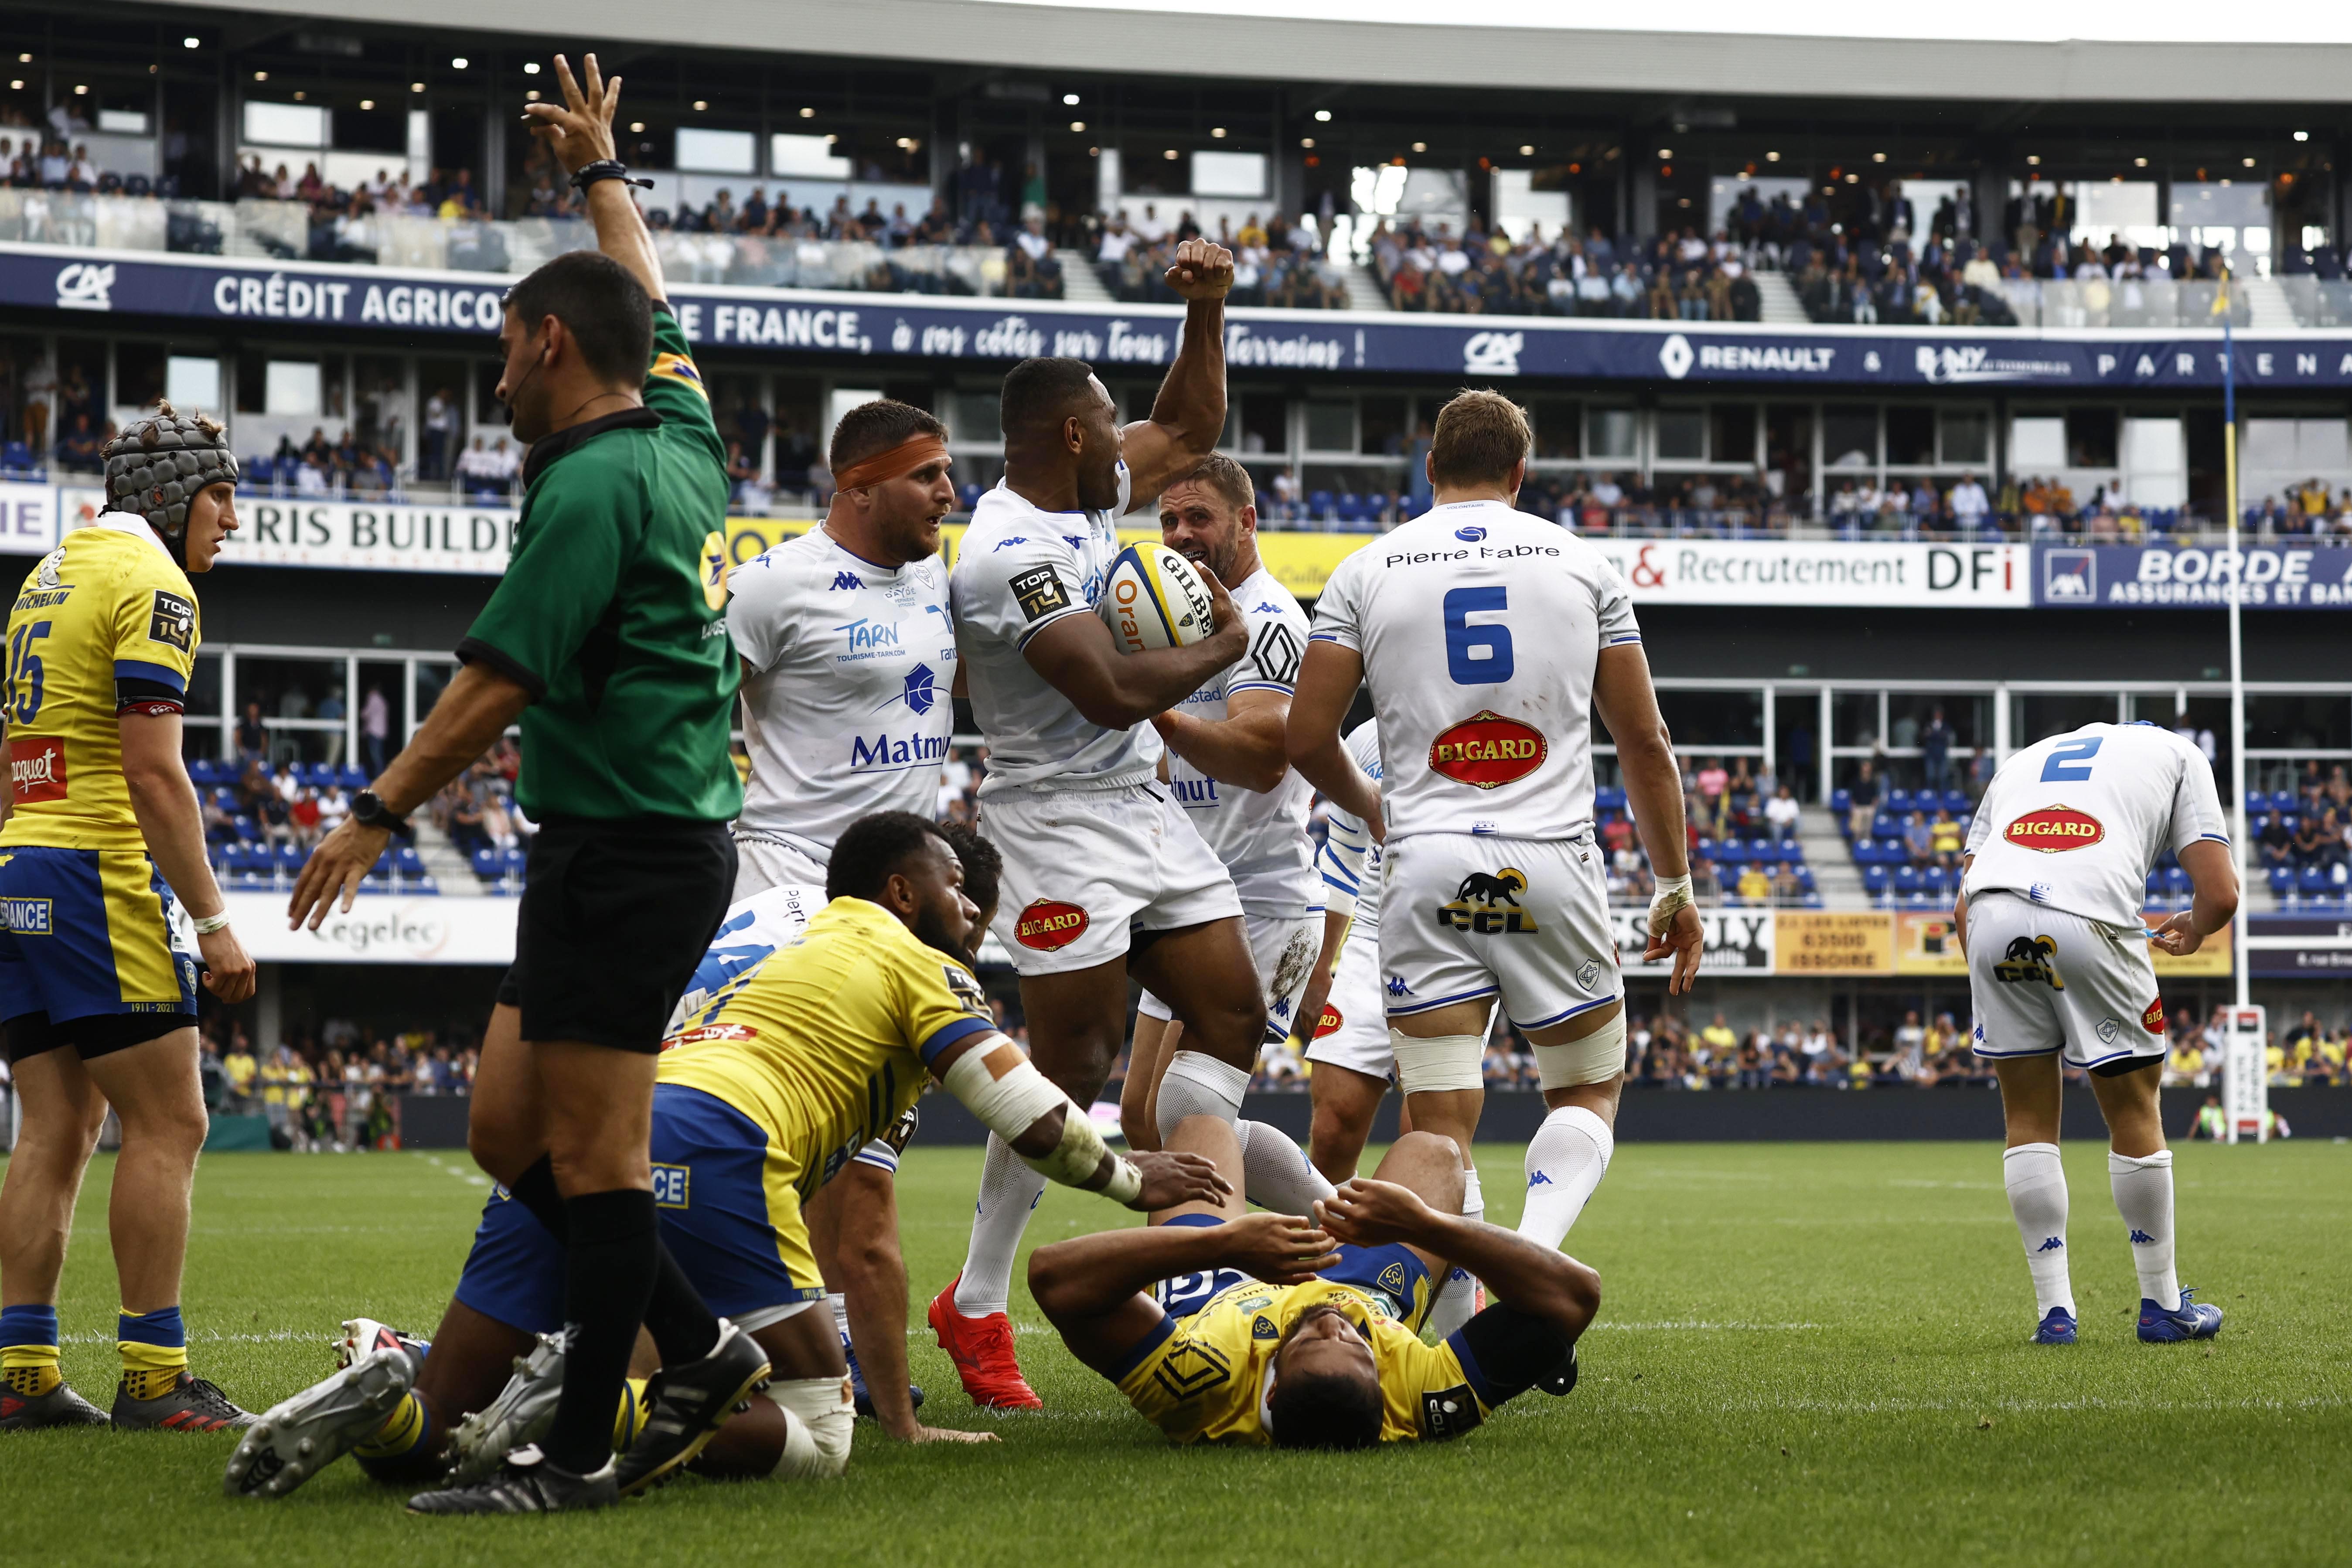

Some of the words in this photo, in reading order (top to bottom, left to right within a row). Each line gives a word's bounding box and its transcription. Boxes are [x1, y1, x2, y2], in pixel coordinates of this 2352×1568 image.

[214, 273, 349, 321] CRÉDIT
[714, 306, 871, 354] FRANCE,
[1700, 345, 1834, 372] RENAULT
[1865, 351, 1881, 372] &
[1386, 549, 1469, 568] Pierre
[1480, 544, 1561, 559] Fabre
[1631, 545, 1666, 589] &
[1677, 549, 1906, 585] Recrutement
[2137, 550, 2314, 584] BORDE
[1016, 571, 1051, 590] TOP
[1927, 549, 2012, 591] DFi
[14, 592, 70, 612] MICHELIN
[161, 597, 191, 617] TOP
[1029, 590, 1063, 614] 14
[160, 621, 187, 646] 14
[1191, 608, 1202, 635] MATCHBALL
[833, 618, 897, 653] TARN
[1443, 586, 1514, 685] 6
[837, 649, 906, 662] TOURISME-TARN.COM
[8, 621, 52, 724] 15
[1438, 739, 1536, 764] BIGARD
[2040, 736, 2104, 783] 2
[2011, 821, 2096, 838] BIGARD
[1021, 913, 1081, 936] BIGARD
[1437, 907, 1538, 934] CCL
[1430, 1399, 1445, 1434] TOP
